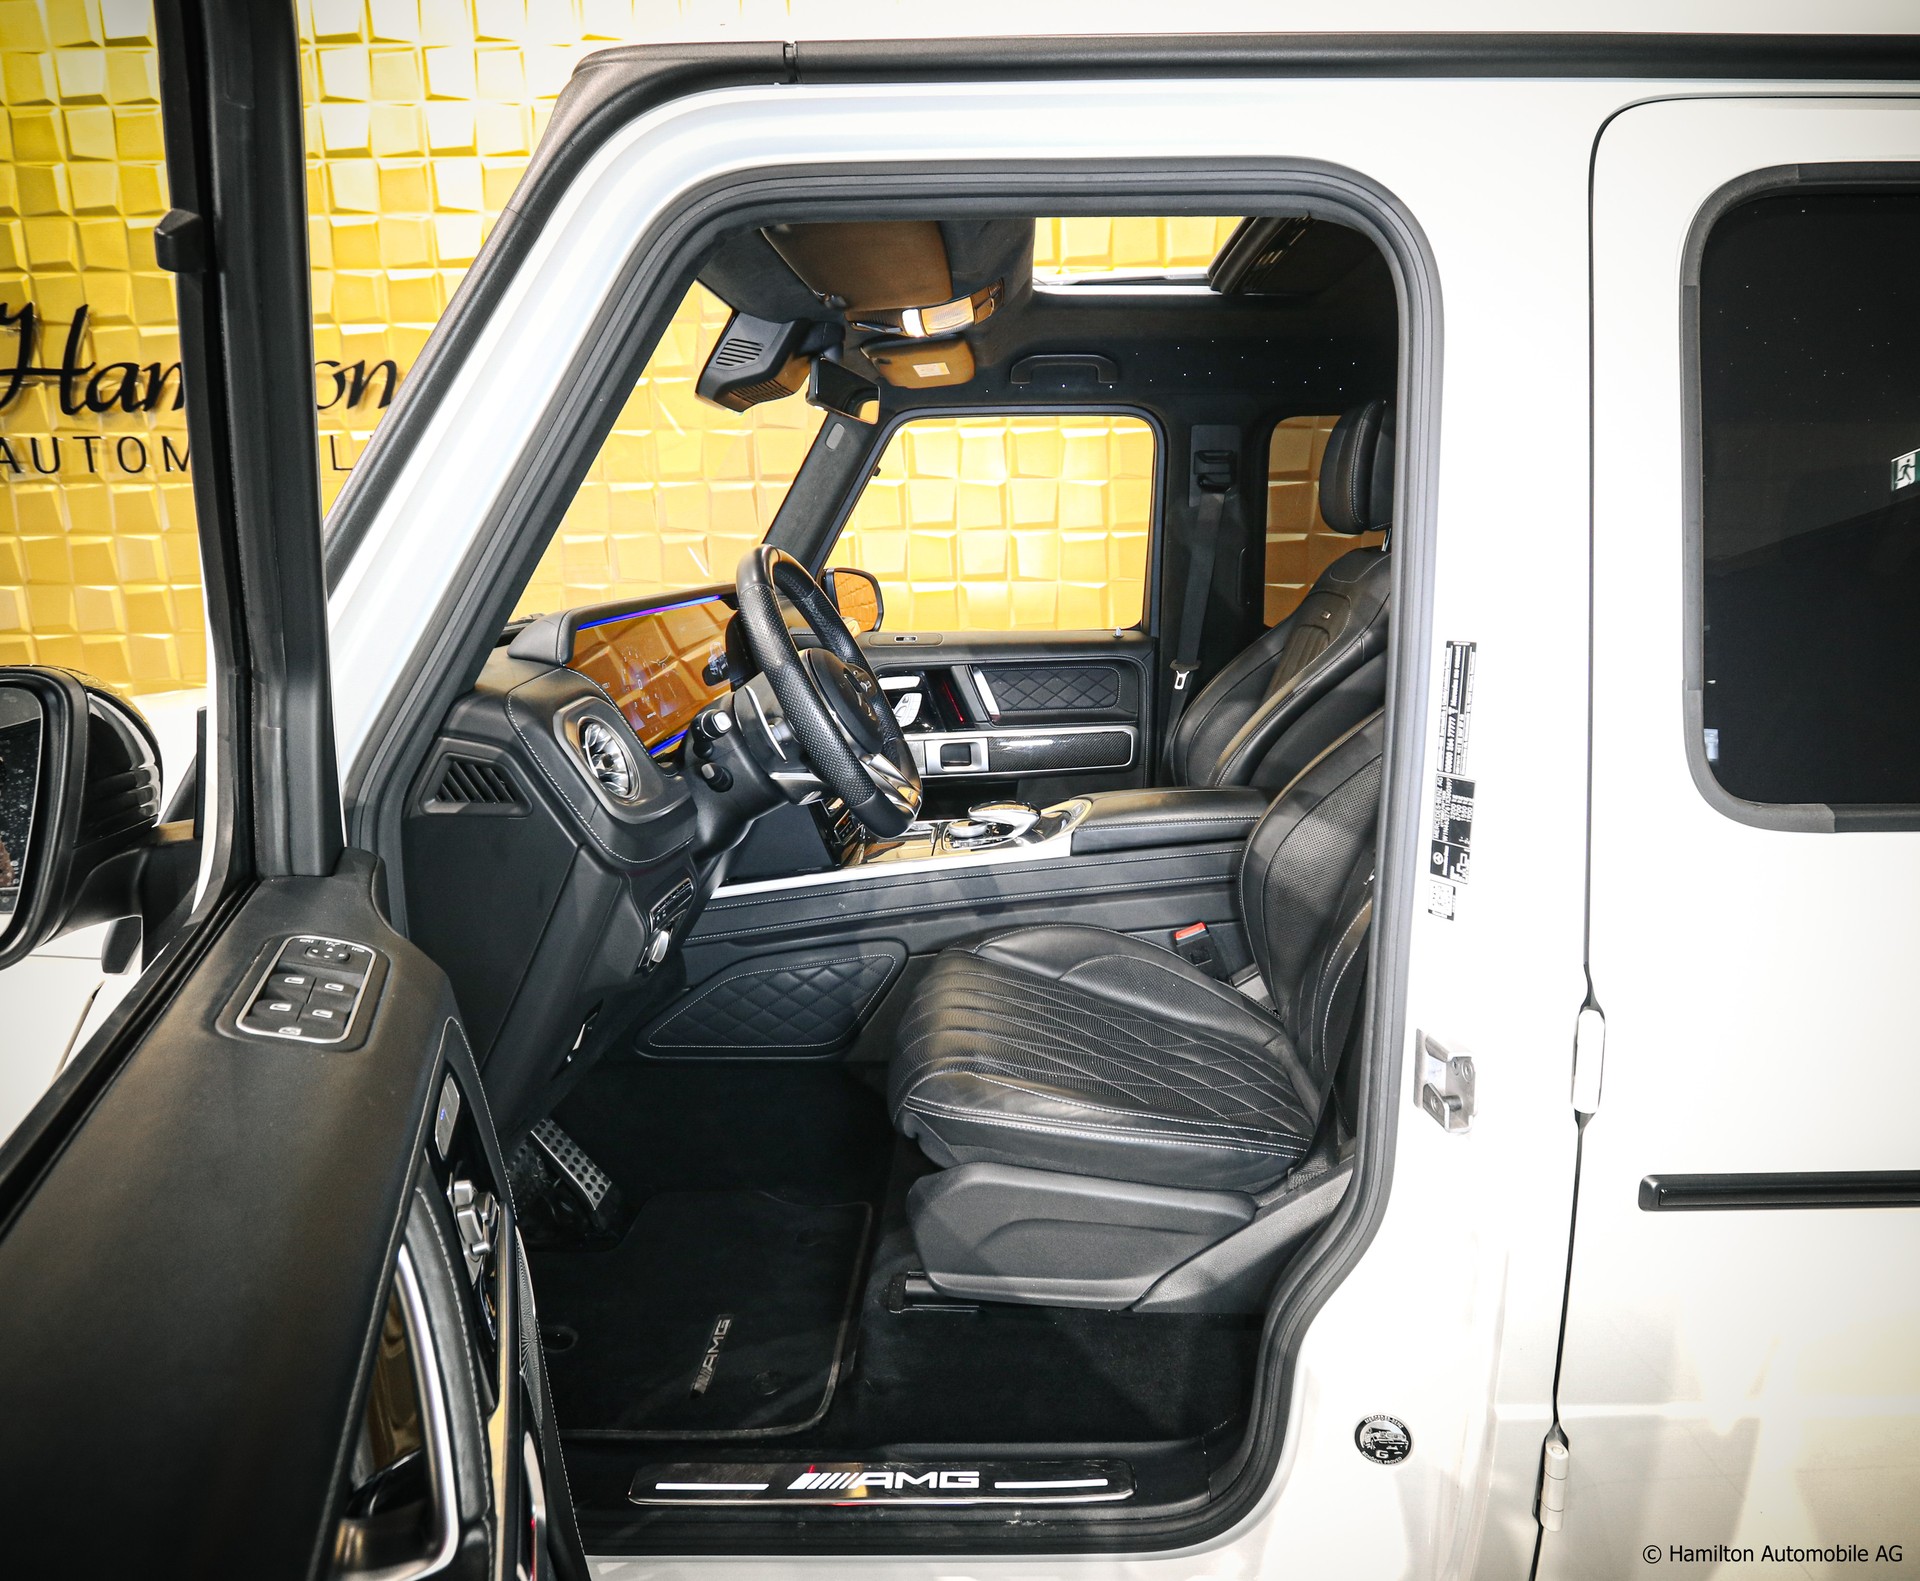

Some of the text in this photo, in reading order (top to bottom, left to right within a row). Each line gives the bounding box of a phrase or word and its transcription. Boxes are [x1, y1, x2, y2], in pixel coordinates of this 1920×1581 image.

[0, 301, 397, 415] Hamon
[702, 1319, 731, 1372] AMG
[1376, 1450, 1388, 1458] G
[855, 1471, 981, 1490] AMG
